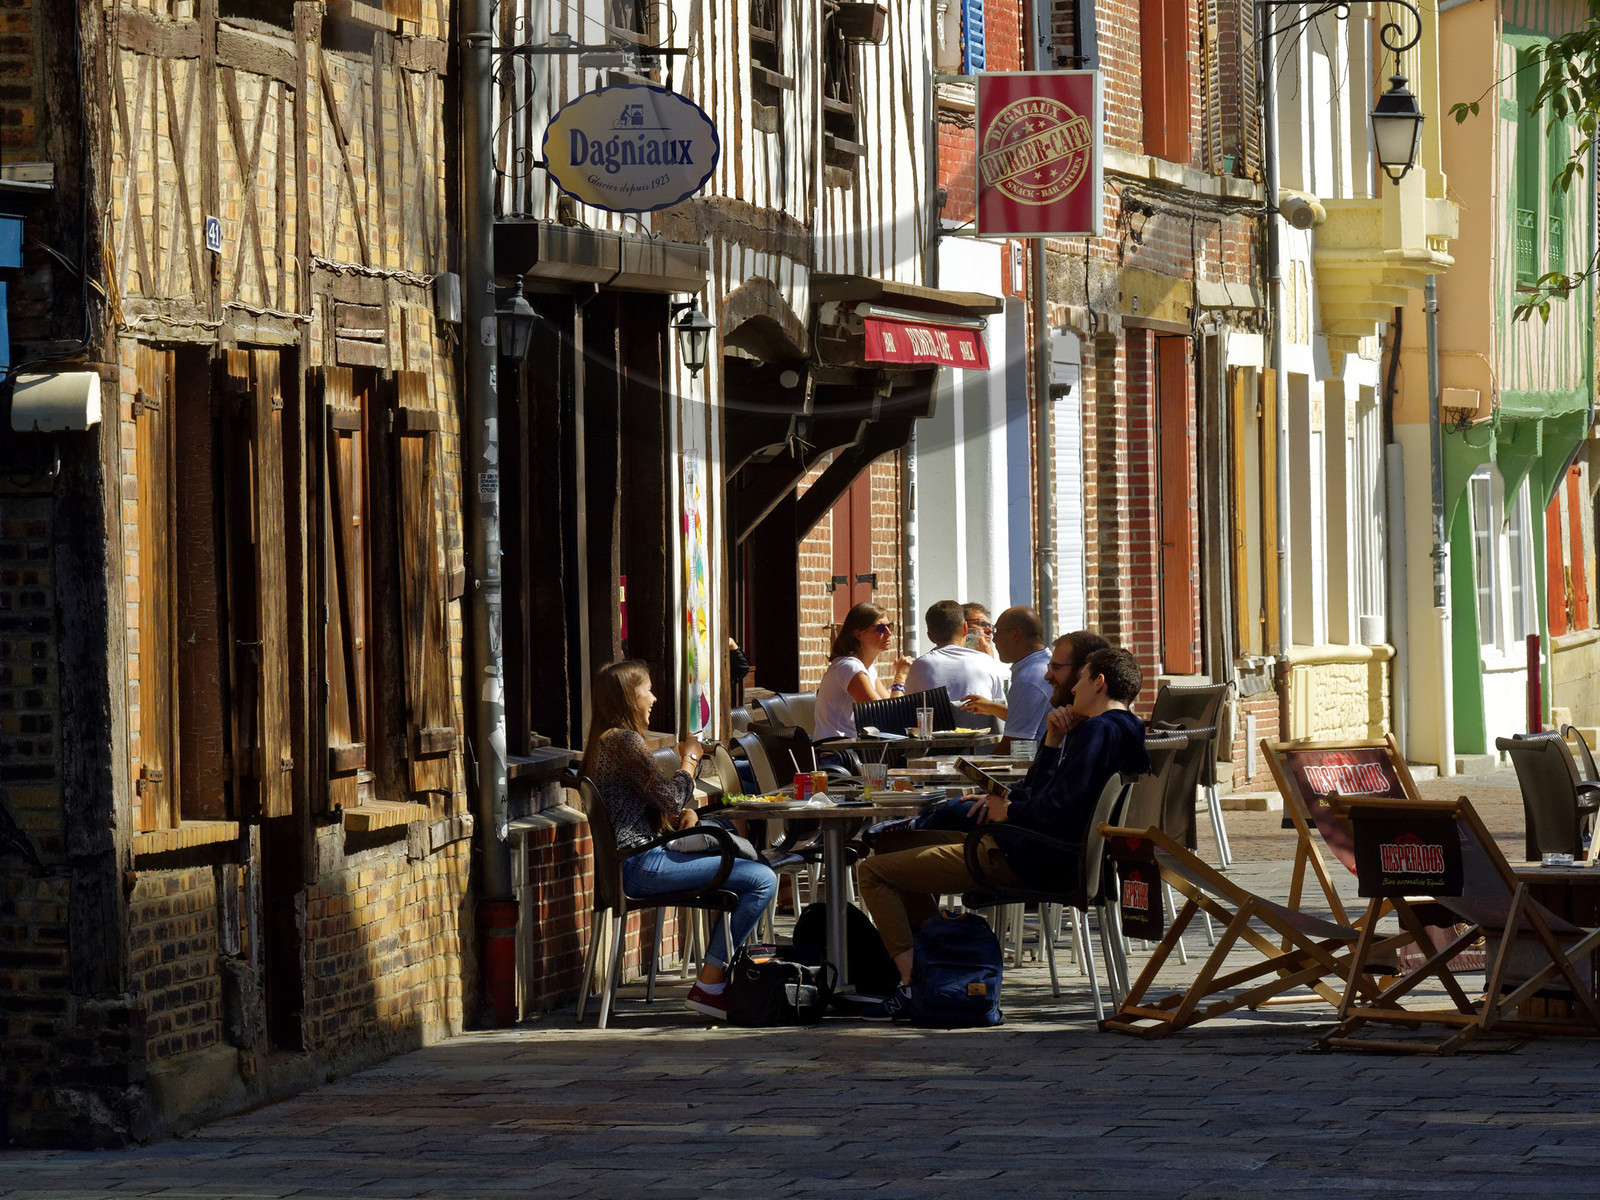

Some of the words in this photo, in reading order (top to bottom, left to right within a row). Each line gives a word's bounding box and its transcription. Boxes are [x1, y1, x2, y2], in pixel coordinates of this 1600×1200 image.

[991, 102, 1060, 141] DAGNIAUX
[569, 128, 694, 175] Dagniaux
[983, 121, 1090, 181] BURGER-CAFE
[587, 174, 618, 192] Glacier
[619, 181, 649, 197] depuis
[651, 174, 670, 190] 1925
[1005, 180, 1035, 198] SNACK
[1041, 185, 1060, 198] BAR
[209, 222, 220, 246] 41
[1303, 763, 1391, 796] DESPERADOS
[1380, 844, 1445, 874] DESPERADOS
